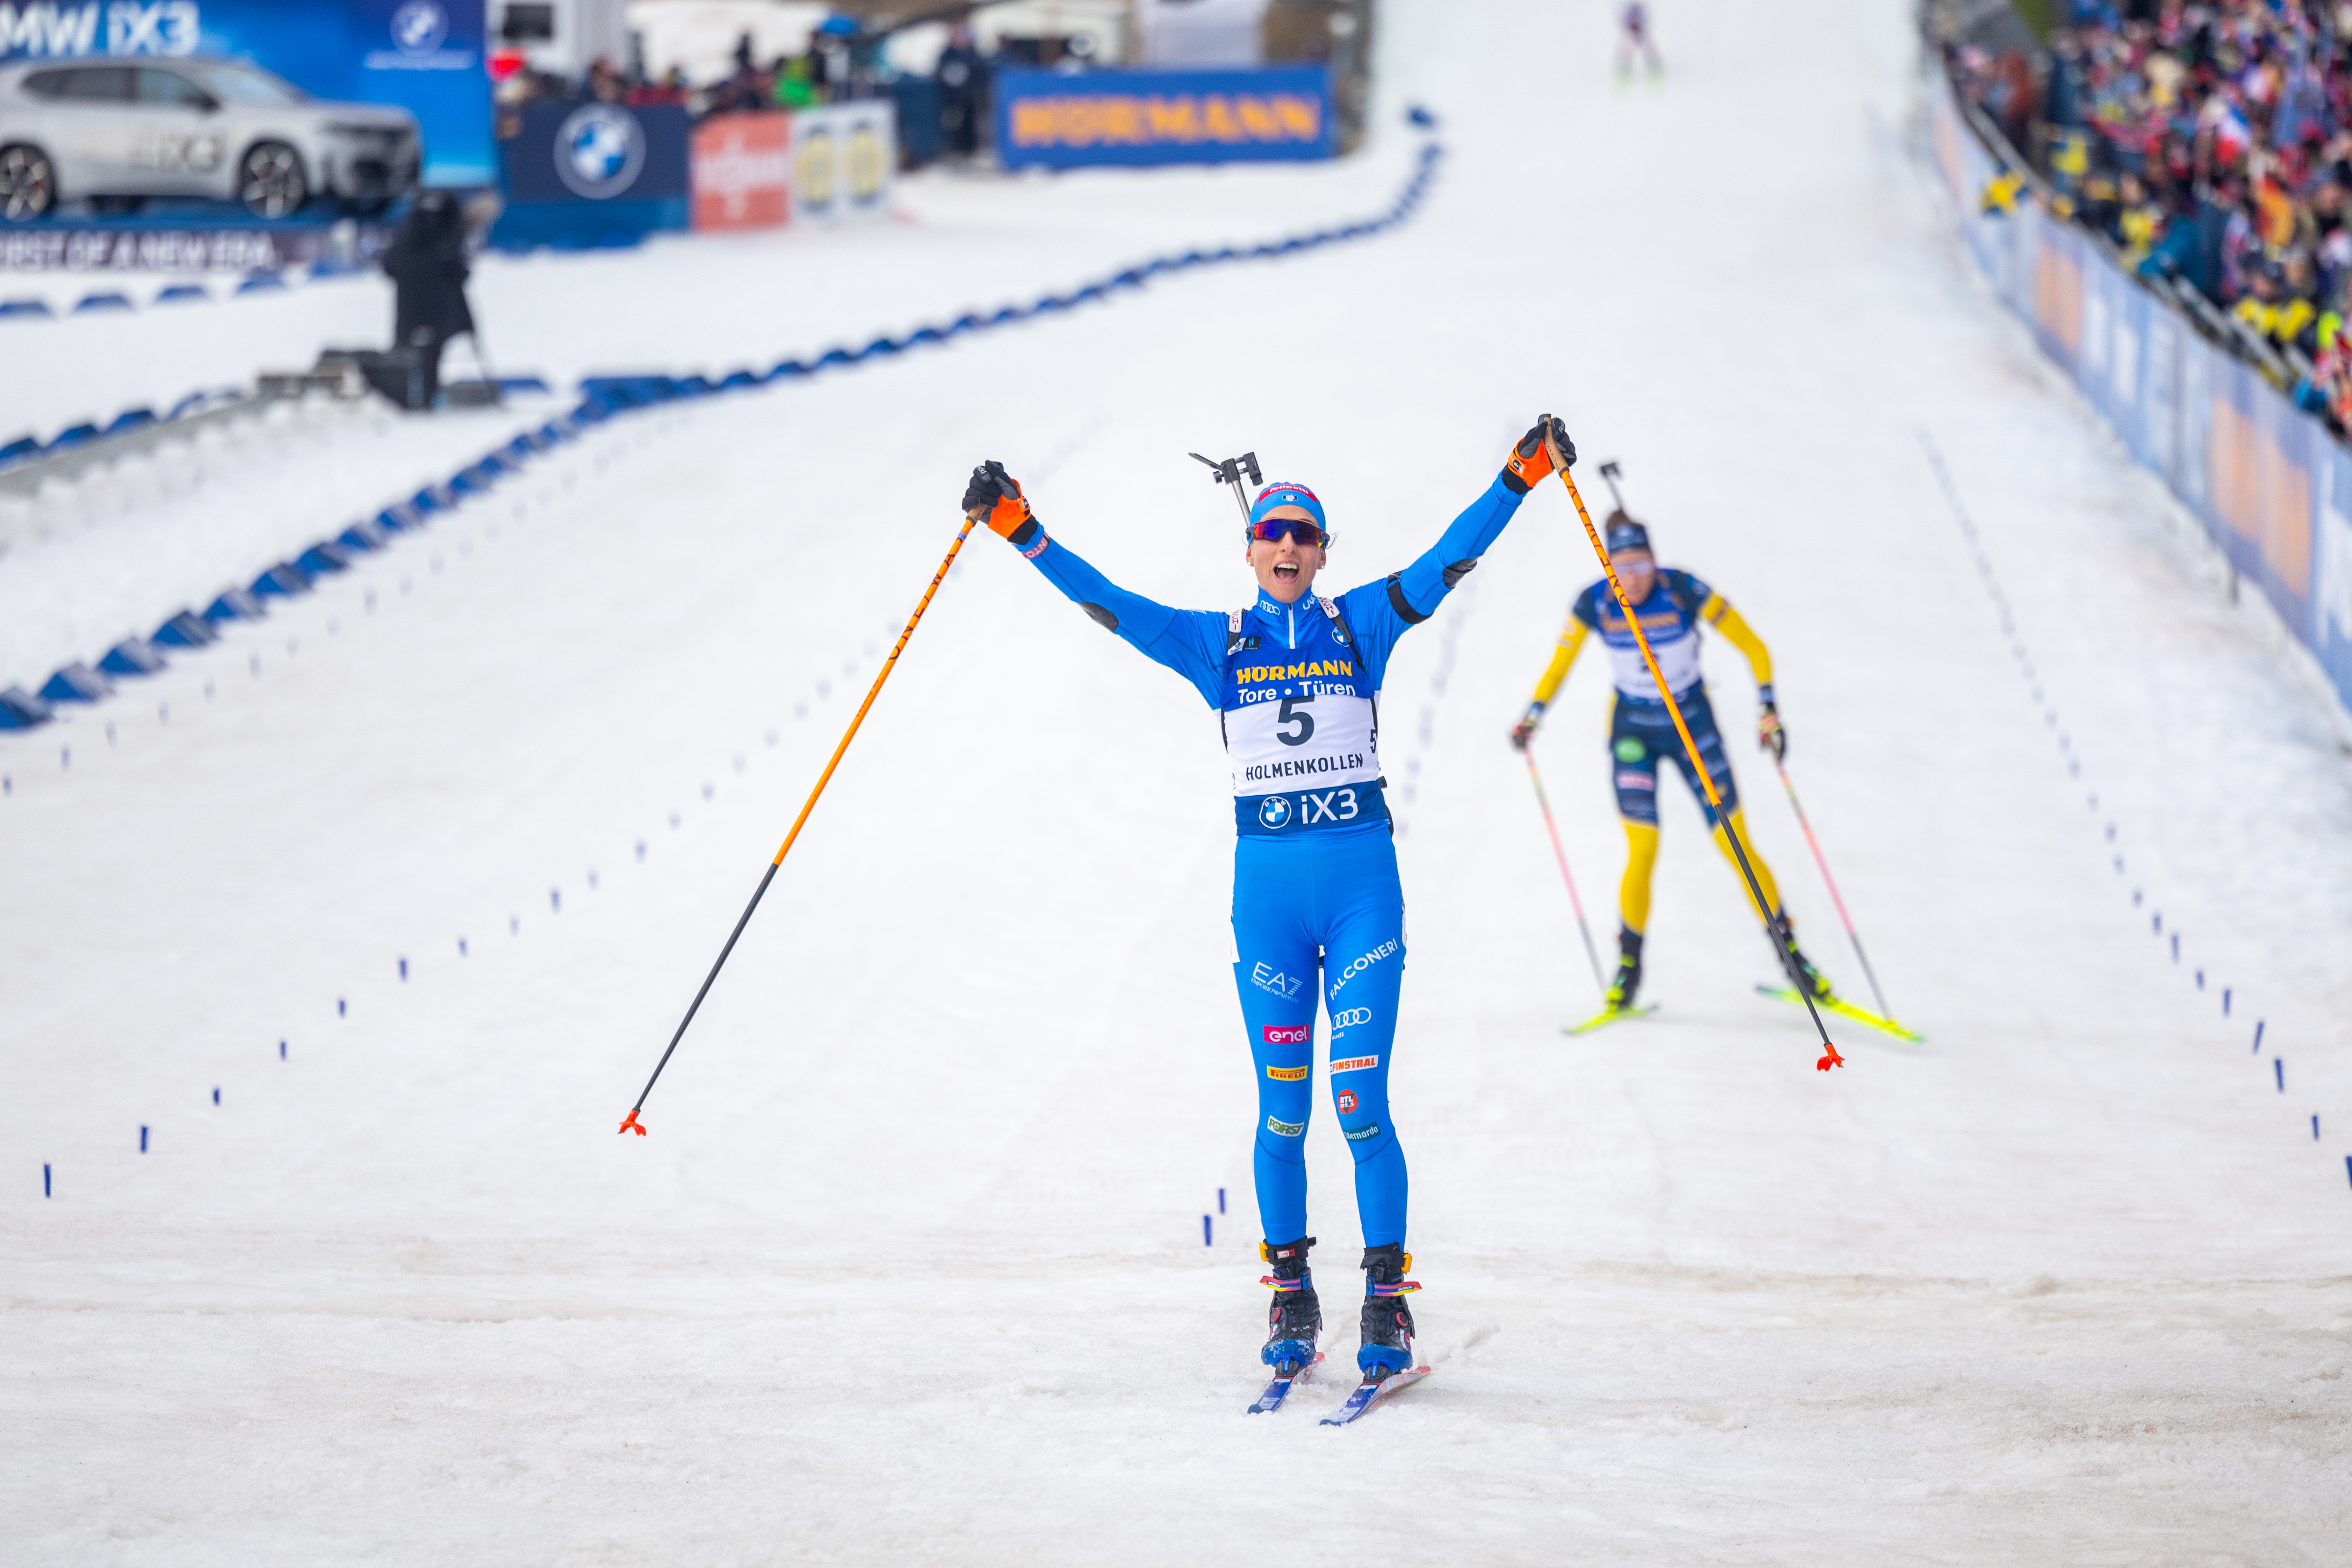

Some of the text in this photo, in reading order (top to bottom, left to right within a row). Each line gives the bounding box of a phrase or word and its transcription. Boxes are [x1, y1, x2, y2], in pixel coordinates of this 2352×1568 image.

[1236, 660, 1352, 684] HÖRMANN
[1238, 680, 1356, 704] Tore Türen
[1276, 695, 1315, 746] 5
[1246, 753, 1363, 781] HOLMENKOLLEN
[1301, 789, 1358, 824] iX3
[1252, 961, 1303, 996] EA7
[1330, 938, 1398, 1001] FALCONERI
[1251, 977, 1299, 1004] EMPORIO ARMANI
[1269, 1026, 1308, 1043] enel
[1332, 1031, 1344, 1041] Audi
[1270, 1068, 1305, 1079] PIRELLI
[1333, 1057, 1376, 1072] FINSTRAL
[1340, 1095, 1353, 1104] RTL
[1269, 1118, 1304, 1135] FORST
